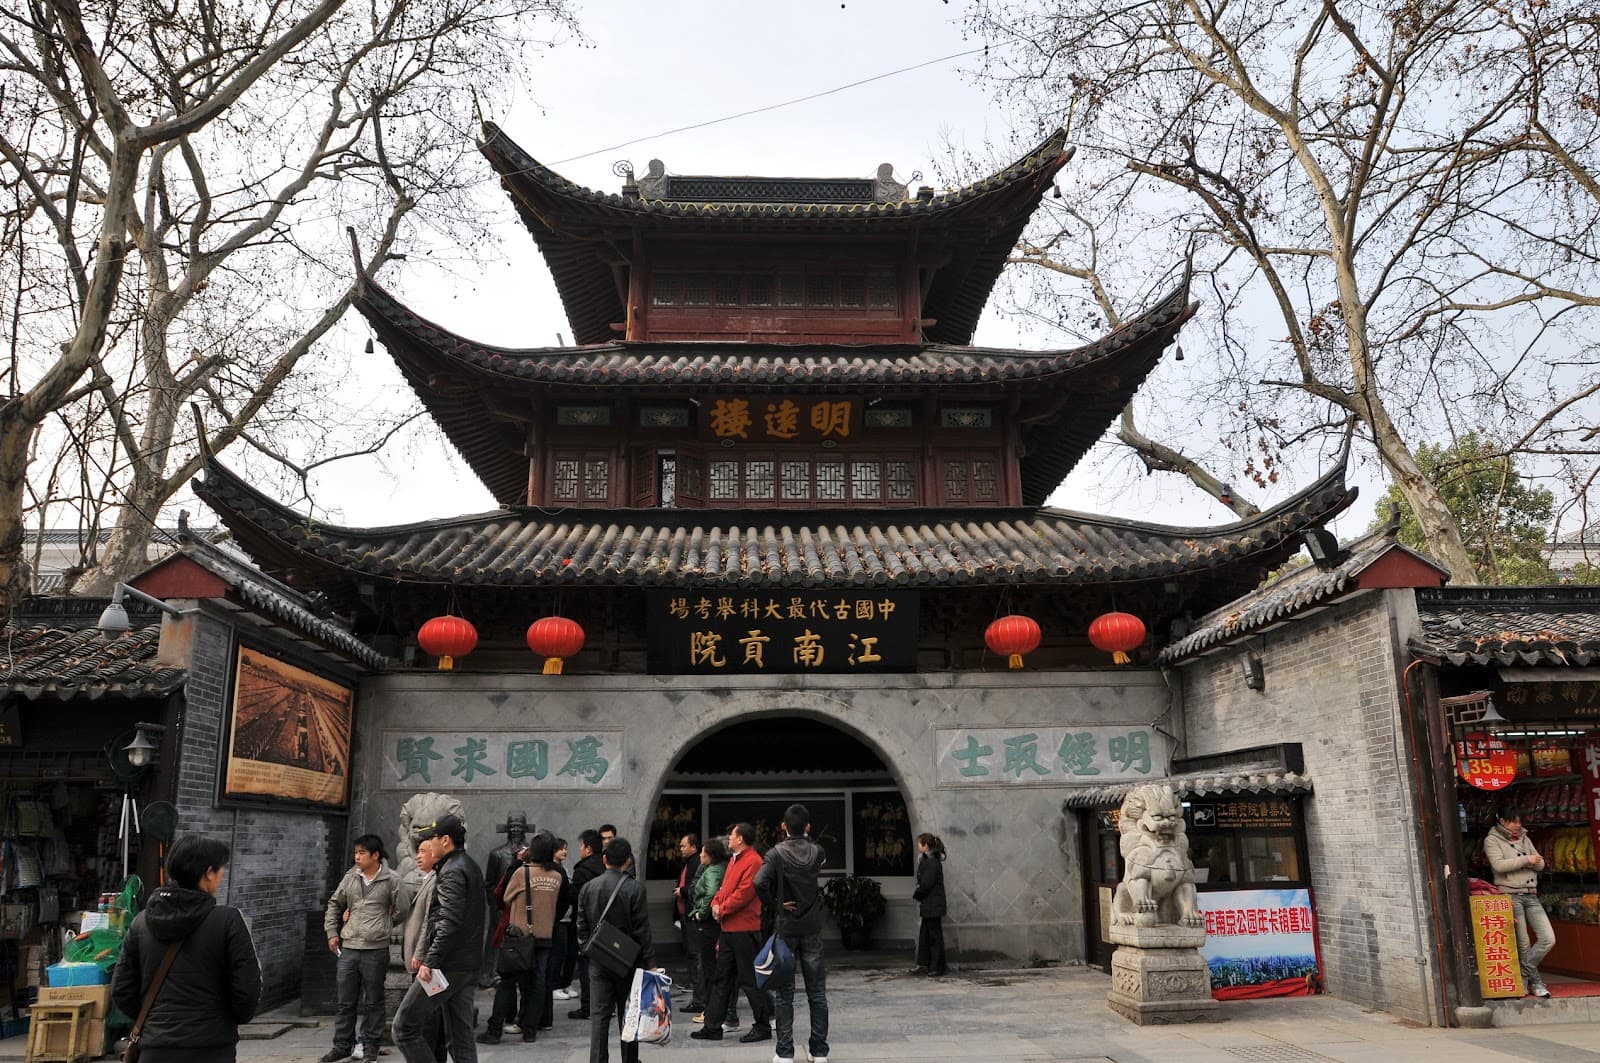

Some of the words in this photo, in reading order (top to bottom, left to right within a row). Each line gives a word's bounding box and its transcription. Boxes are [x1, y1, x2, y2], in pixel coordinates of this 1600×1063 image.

[1475, 900, 1510, 912] 厂家直销
[1199, 907, 1311, 936] 年南京公园年卡销售处
[1480, 914, 1516, 993] 特价盐水鸭
